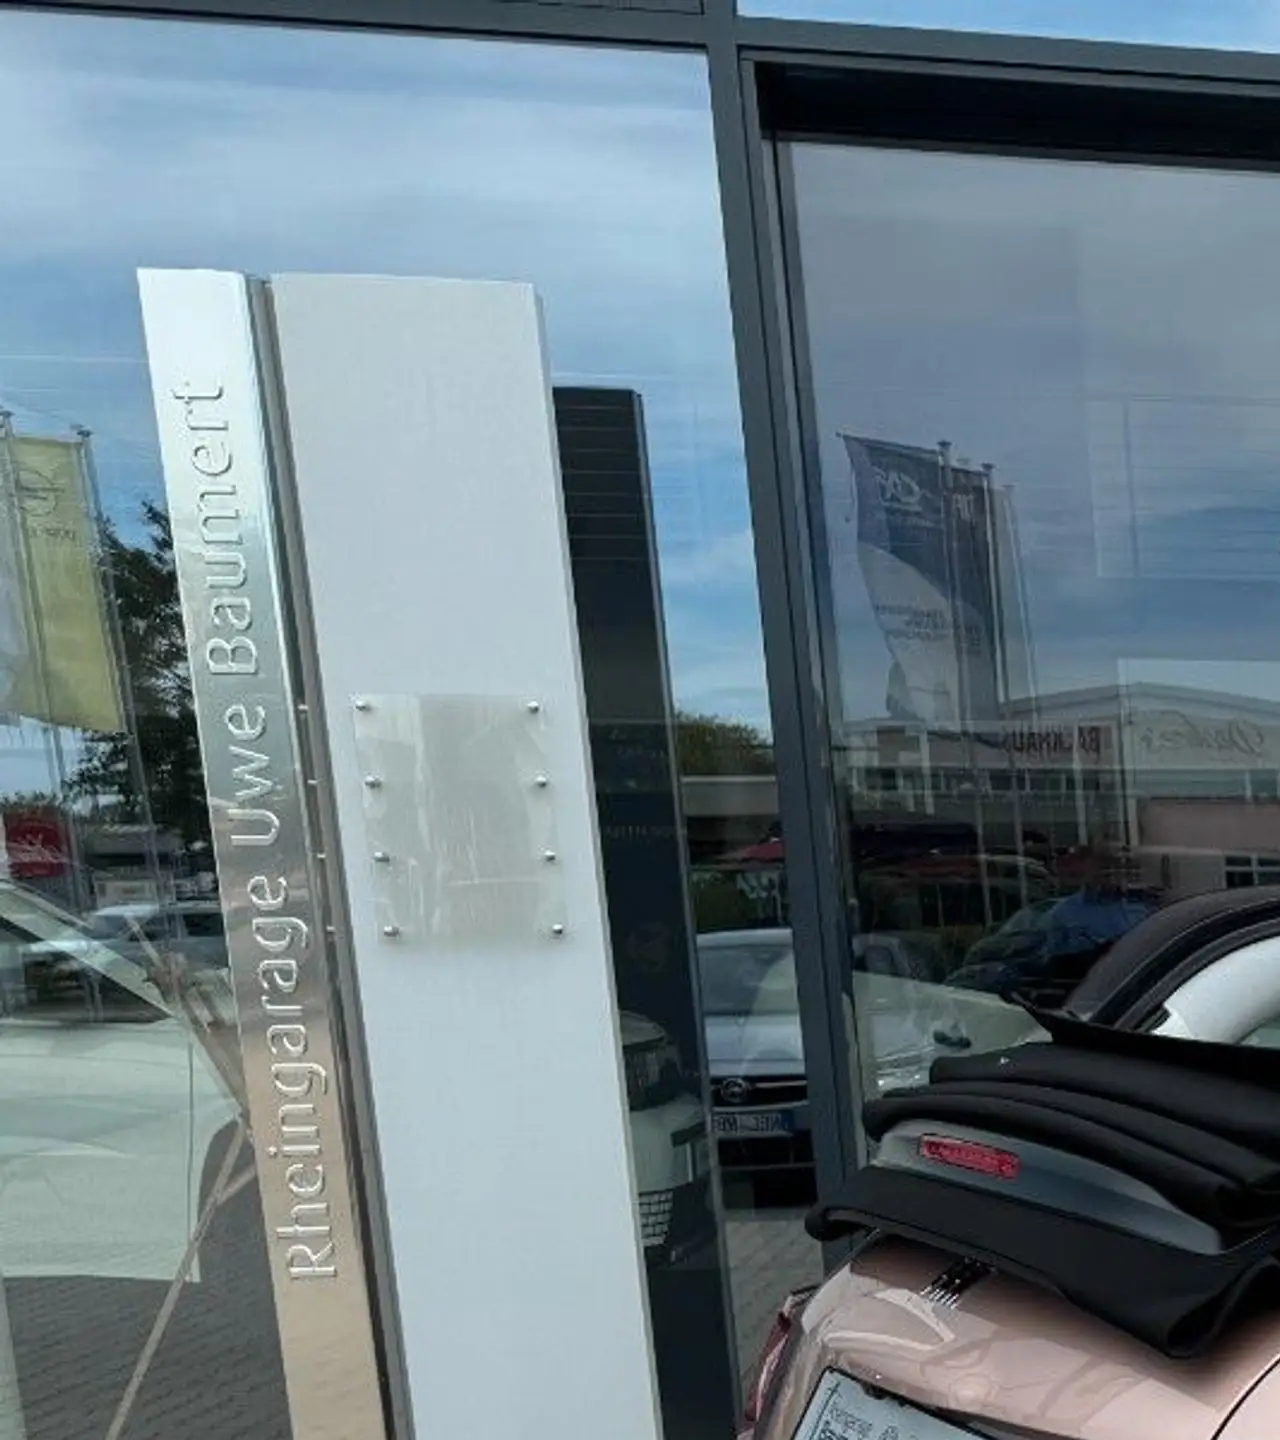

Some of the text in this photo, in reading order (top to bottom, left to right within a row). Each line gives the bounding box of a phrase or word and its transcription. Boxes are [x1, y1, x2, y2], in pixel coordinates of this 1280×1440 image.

[171, 379, 338, 1279] Rheingarage Uwe Baumert
